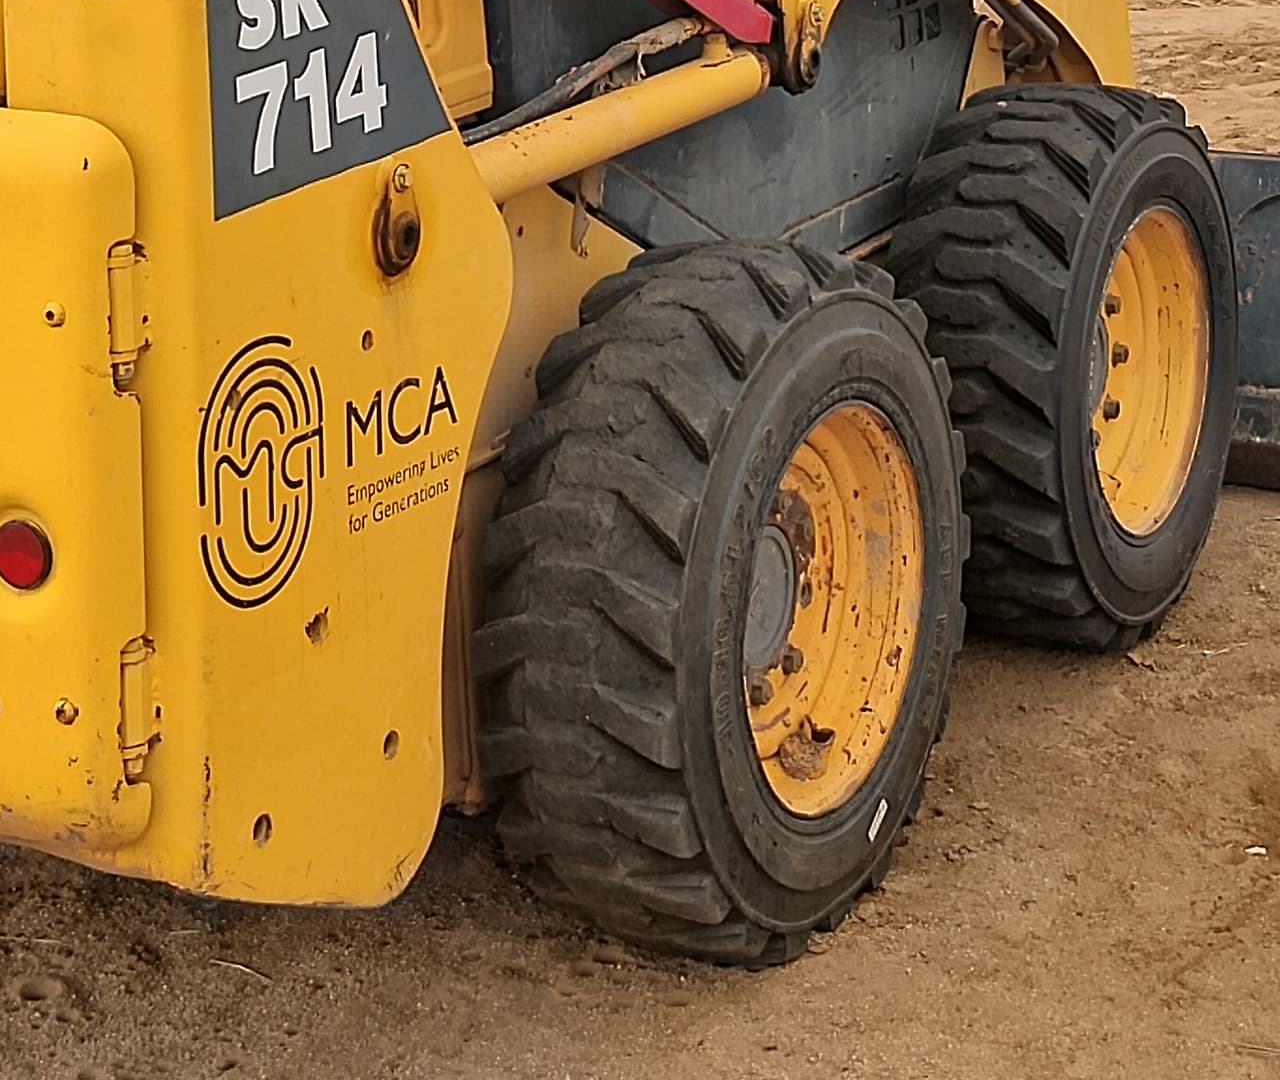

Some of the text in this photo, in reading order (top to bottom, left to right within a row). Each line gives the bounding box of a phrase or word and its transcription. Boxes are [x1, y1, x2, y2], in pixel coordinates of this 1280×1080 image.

[235, 31, 388, 176] 714
[346, 366, 458, 468] MCA
[346, 445, 460, 506] Empowering Lives
[348, 477, 450, 535] for Generations
